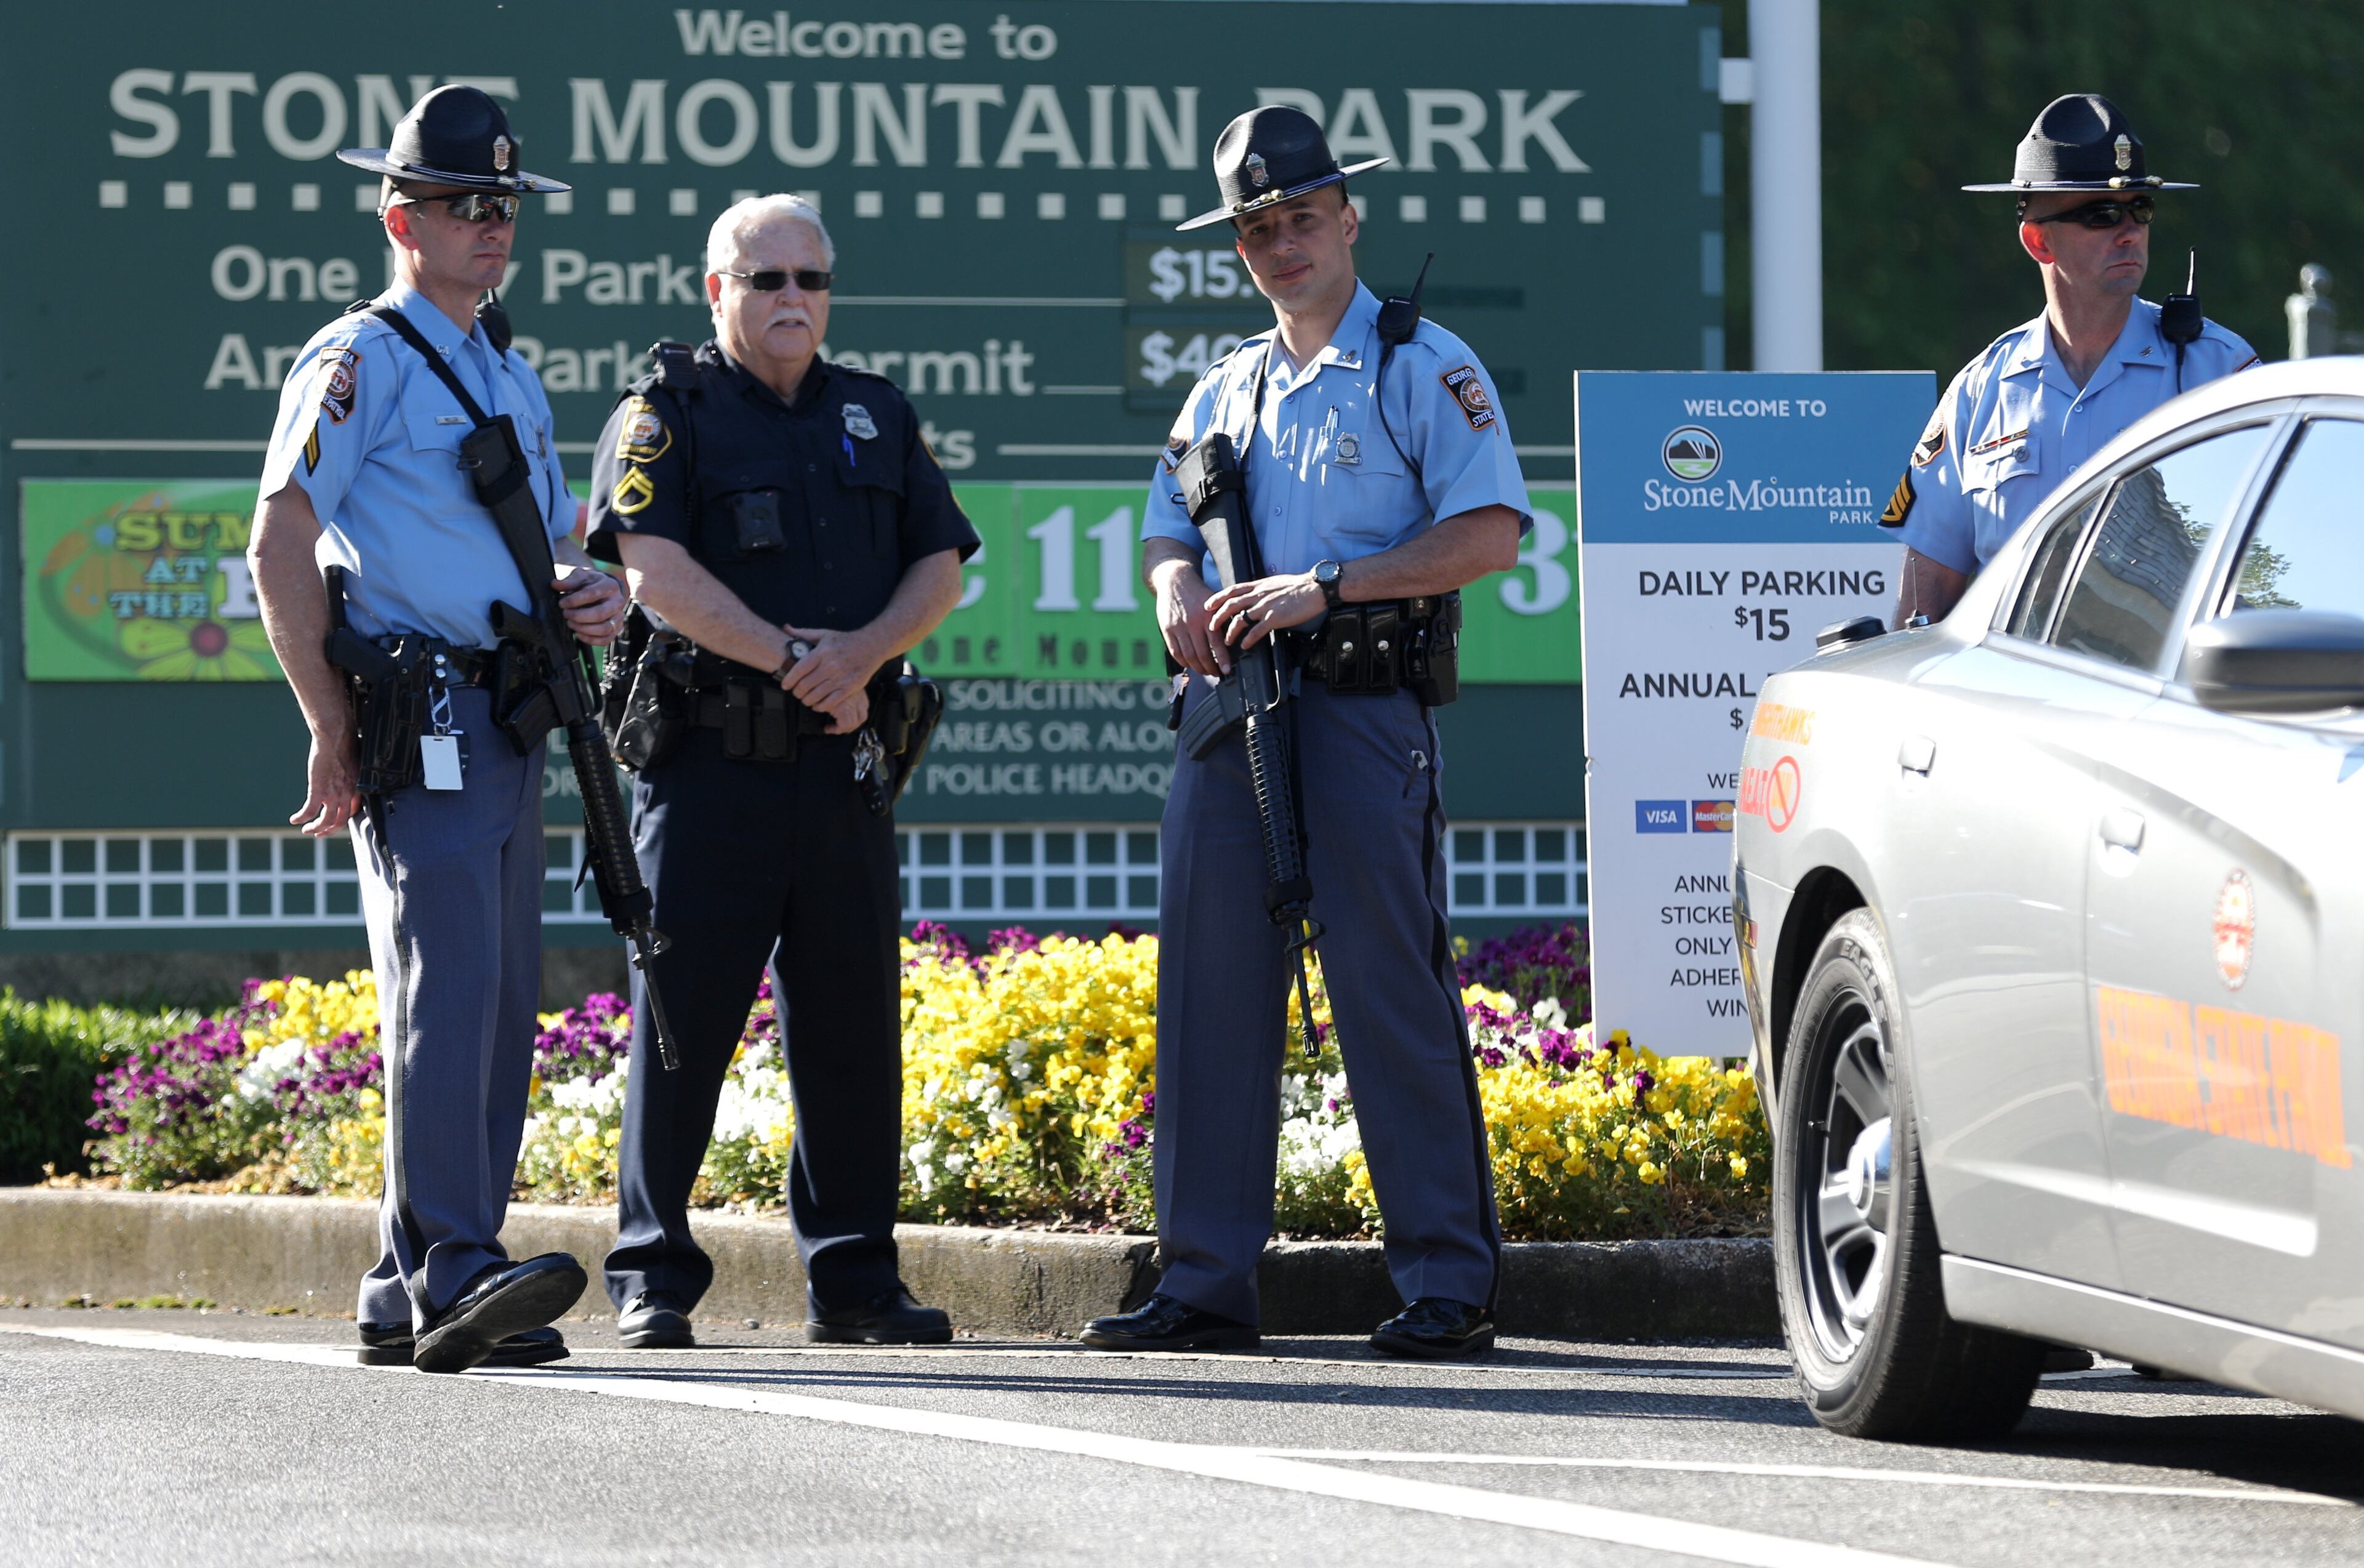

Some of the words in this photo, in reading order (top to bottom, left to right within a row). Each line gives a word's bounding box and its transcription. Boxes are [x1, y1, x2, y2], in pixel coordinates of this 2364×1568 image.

[675, 9, 965, 59] Welcome
[989, 14, 1058, 61] to
[109, 68, 520, 161] STON
[569, 78, 1200, 170] MOUNTAIN
[211, 245, 360, 303] One
[541, 248, 712, 306] Park
[1149, 246, 1255, 304] $15.
[510, 336, 675, 393] Park
[1447, 368, 1476, 385] GEORG
[1684, 399, 1790, 417] WELCOME
[1796, 399, 1827, 417] TO
[117, 512, 252, 551] SUM
[1829, 511, 1873, 524] PARK
[143, 556, 207, 584] AT
[1026, 505, 1140, 612] 11
[1639, 571, 1731, 596] DAILY
[1741, 571, 1886, 596] PARKING
[109, 591, 208, 619] THE
[1734, 605, 1791, 641] $15
[947, 680, 1136, 710] SOLICITING
[1619, 673, 1757, 698] ANNUAL
[929, 720, 1034, 753] AREAS
[1040, 720, 1092, 753] OR
[1098, 720, 1175, 753] ALO
[927, 763, 1045, 795] POLICE
[1051, 763, 1174, 798] HEADQ
[1646, 810, 1678, 824] VISA
[1695, 811, 1734, 822] MasterCar
[1674, 875, 1731, 893] ANNU
[1660, 906, 1734, 924] STICKE
[1675, 937, 1732, 955] ONLY
[1670, 968, 1743, 986] ADHER
[1707, 999, 1750, 1018] WIN
